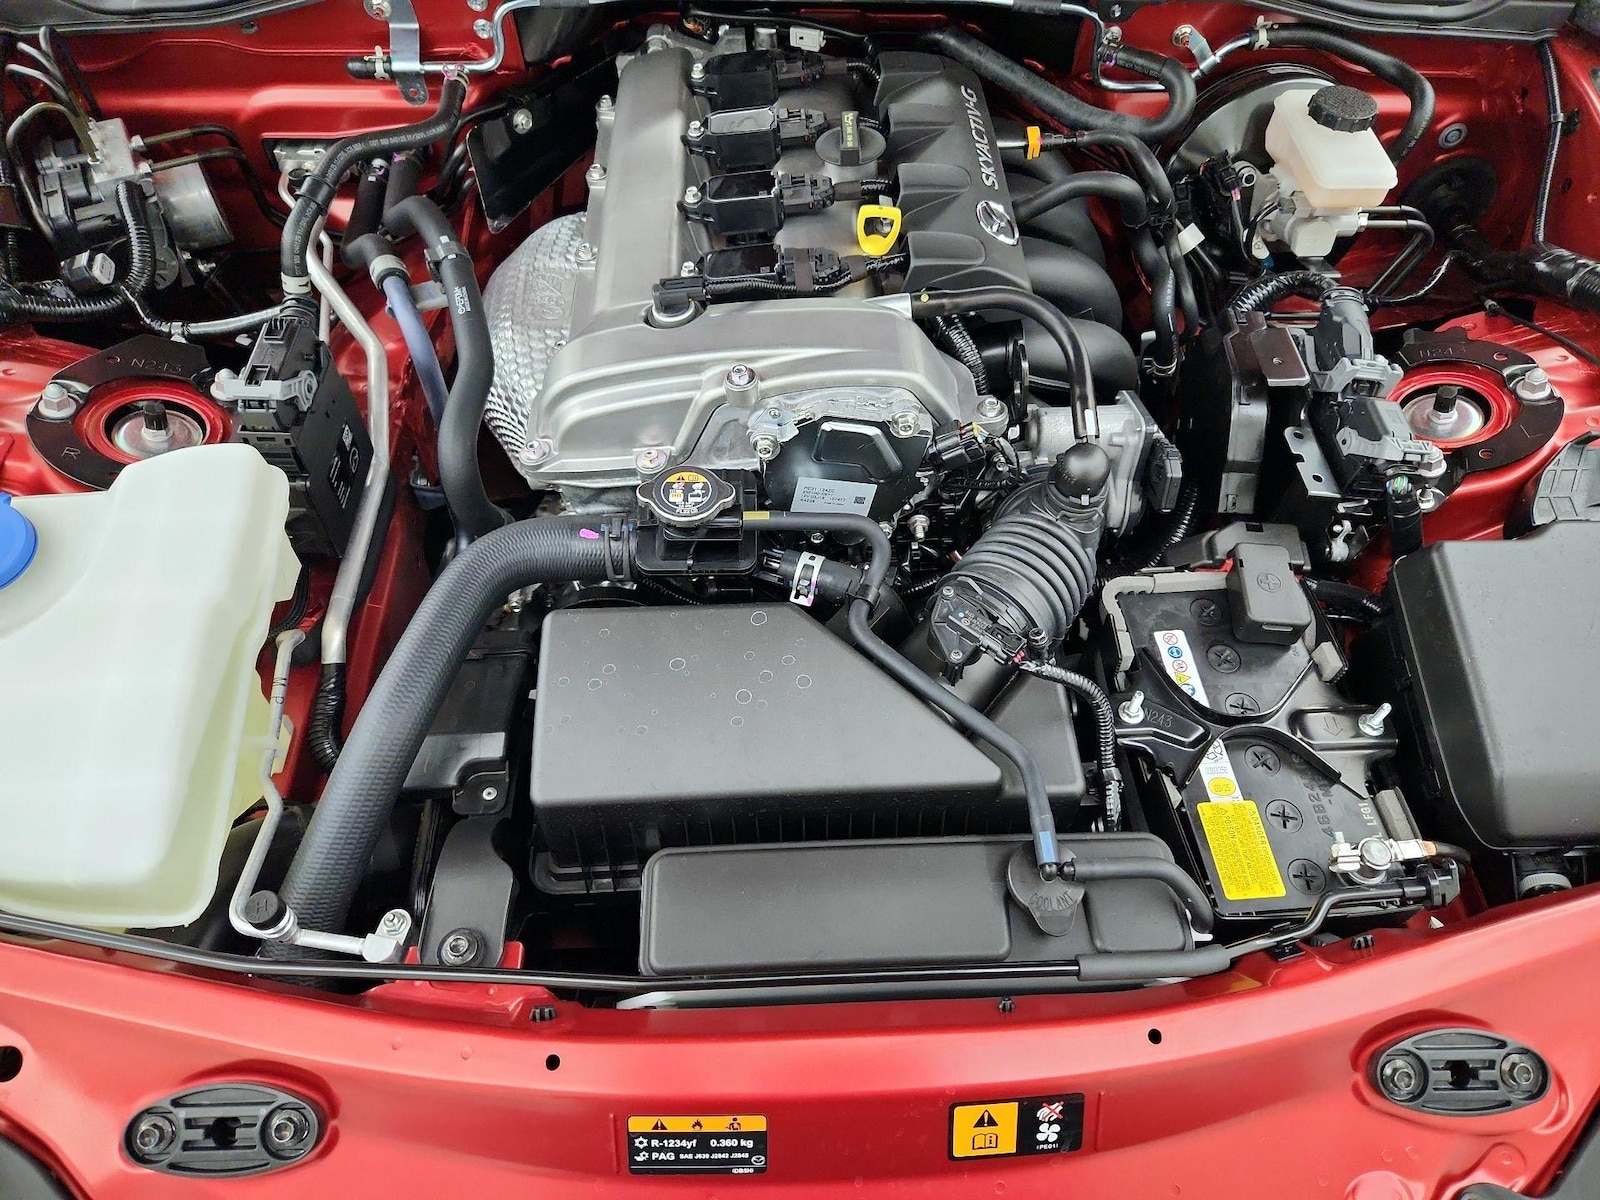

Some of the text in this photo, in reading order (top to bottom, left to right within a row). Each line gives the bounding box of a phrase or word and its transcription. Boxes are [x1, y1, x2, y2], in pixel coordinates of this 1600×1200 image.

[961, 85, 998, 190] SKYACTIV-G
[62, 446, 80, 459] R
[1144, 708, 1173, 728] N243
[1223, 815, 1236, 839] POISON
[1251, 816, 1266, 844] DANGER
[1028, 891, 1074, 912] COOLANT
[650, 1138, 754, 1148] R-1234yf 0.360 kg
[652, 1152, 676, 1160] PAG
